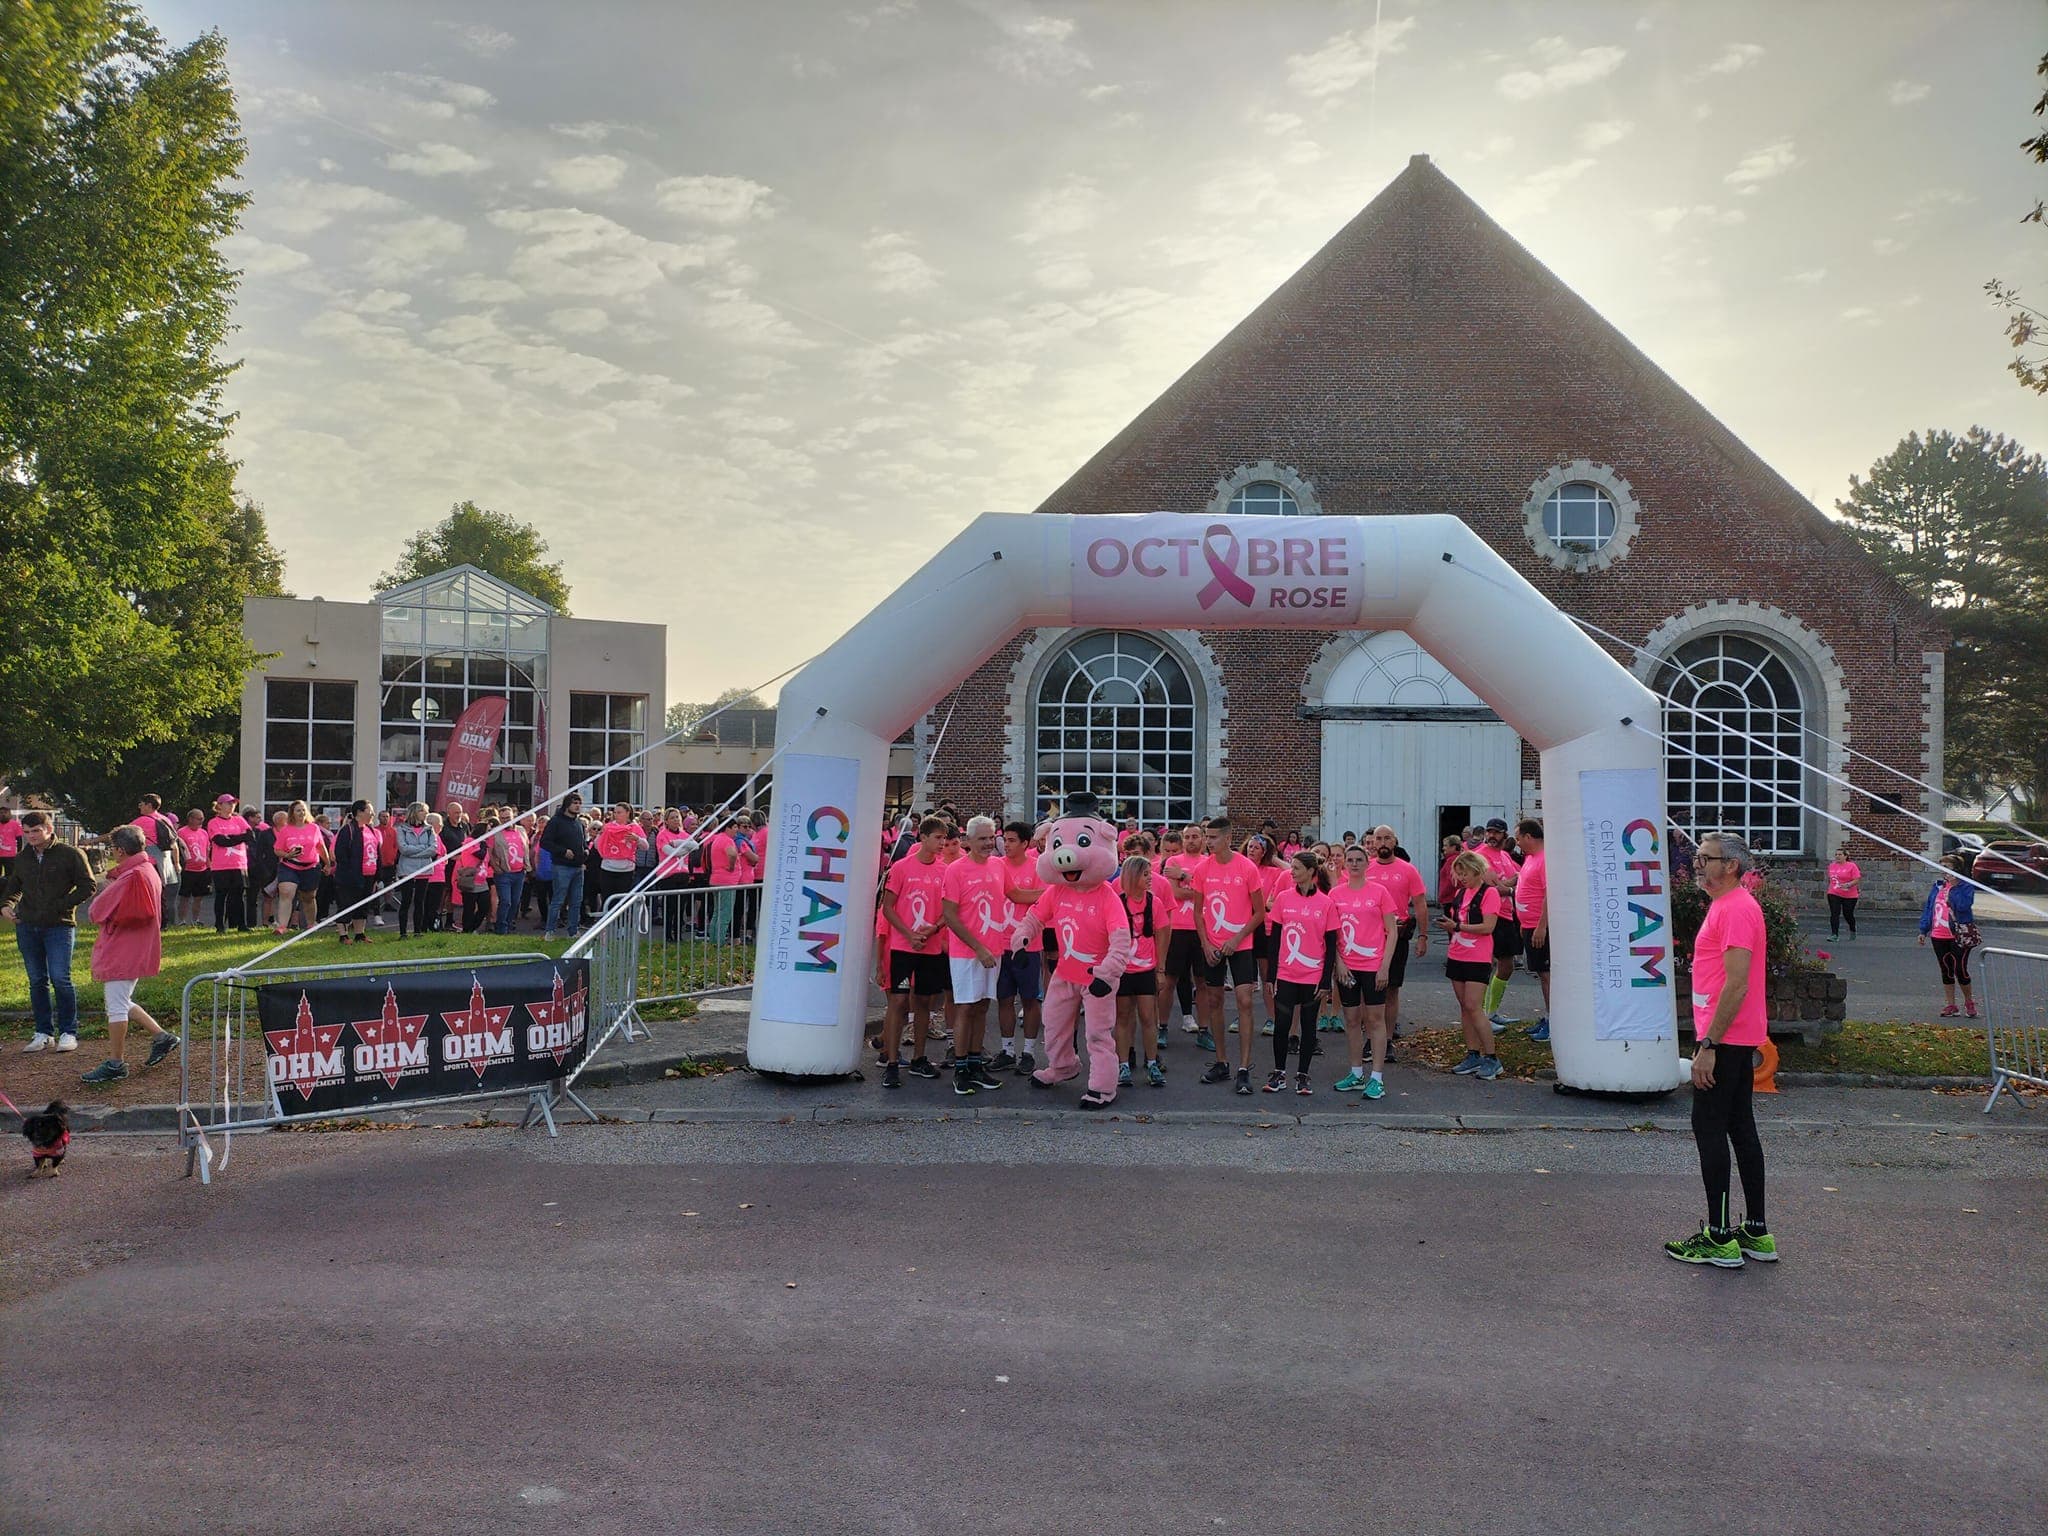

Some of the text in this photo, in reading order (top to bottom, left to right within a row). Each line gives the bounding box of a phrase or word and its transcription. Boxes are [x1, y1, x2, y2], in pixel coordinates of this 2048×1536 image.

[1269, 587, 1347, 609] ROSE
[459, 731, 493, 749] OHM
[448, 780, 481, 798] OHM
[776, 803, 802, 971] CENTRE HOSPITALIER
[794, 805, 850, 974] CHAM
[1600, 820, 1623, 989] CENTRE HOSPITALIER
[1621, 818, 1667, 988] CHAM
[355, 1039, 428, 1071] OHM
[445, 1029, 513, 1060] OHM
[269, 1049, 344, 1082] OHM
[354, 1073, 381, 1083] SPORTS
[443, 1062, 469, 1072] SPORTS
